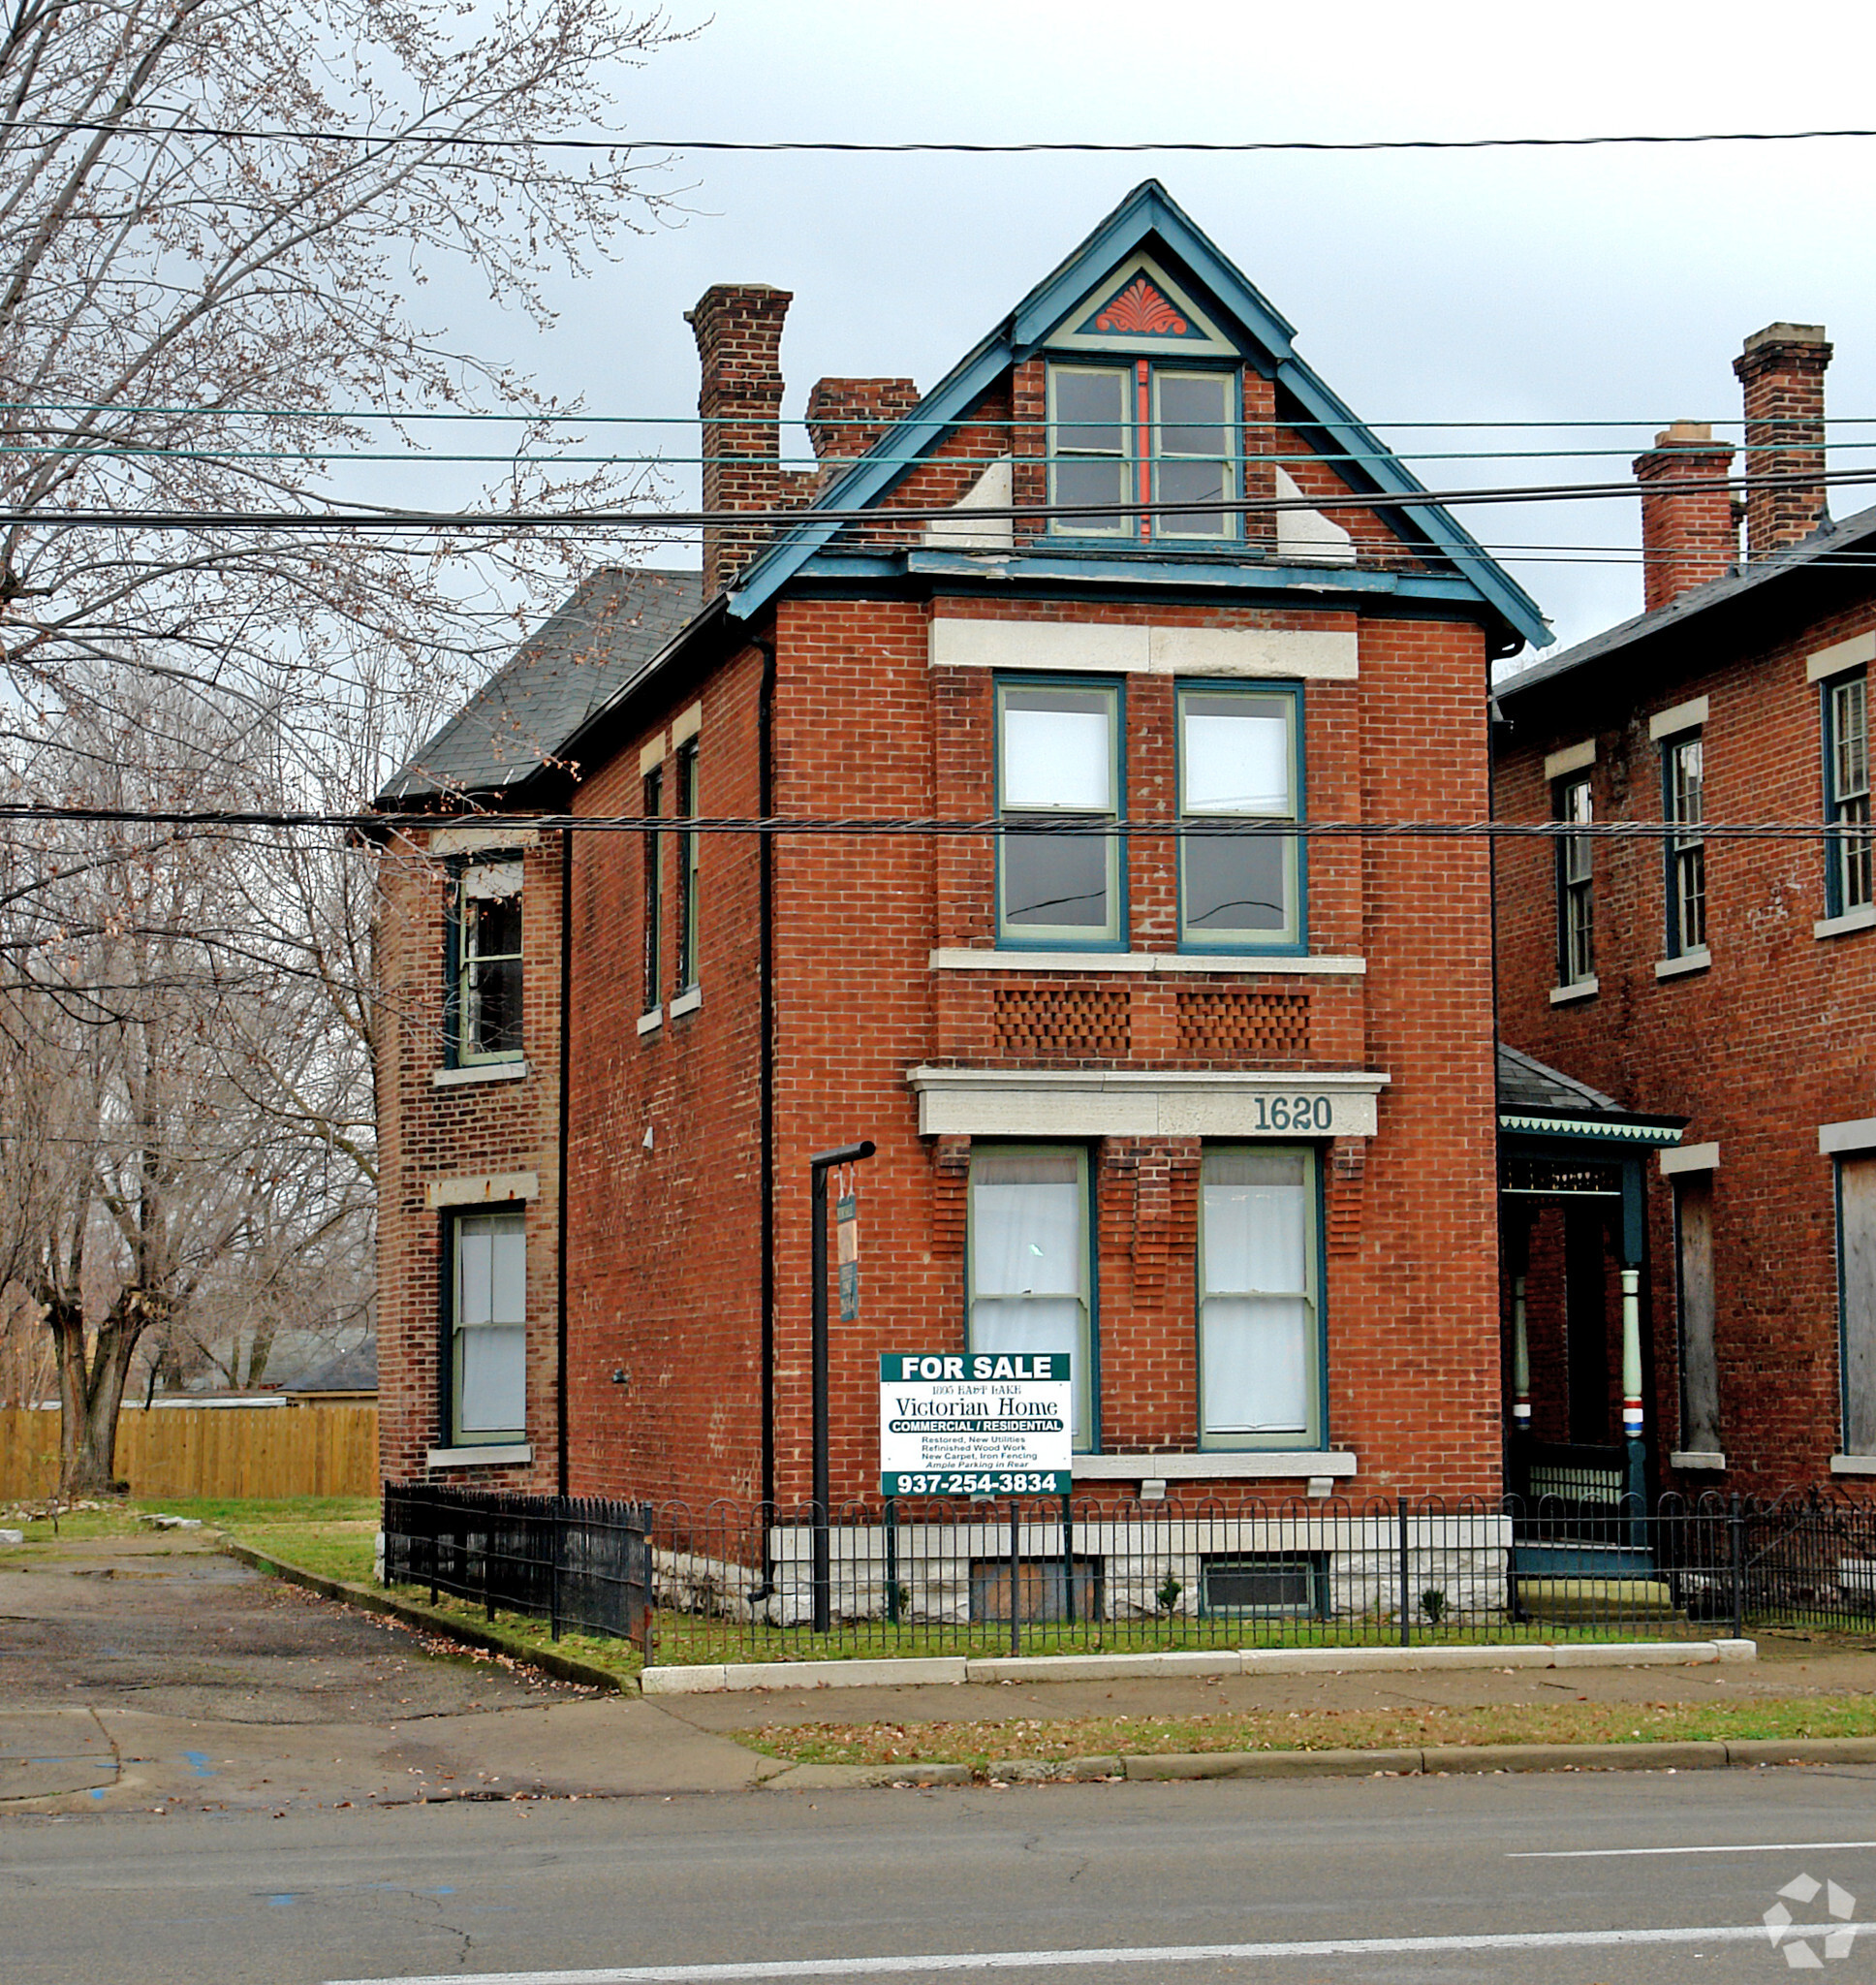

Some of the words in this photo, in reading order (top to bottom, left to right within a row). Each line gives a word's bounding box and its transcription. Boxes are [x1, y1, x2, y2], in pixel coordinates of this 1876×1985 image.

[1254, 1095, 1332, 1130] 1620
[902, 1356, 964, 1379] FOR
[973, 1356, 1052, 1379] SALE
[895, 1398, 989, 1417] Victorian
[997, 1397, 1058, 1416] Home
[891, 1420, 974, 1432] COMMERCIAL
[976, 1421, 982, 1432] /
[983, 1419, 1061, 1432] RESIDENTIAL
[922, 1435, 967, 1444] Restored,
[925, 1461, 956, 1469] Ample
[957, 1461, 993, 1469] Parking
[1007, 1460, 1029, 1468] Rear
[944, 1452, 978, 1462] Carpet,
[1000, 1452, 1038, 1462] Fencing
[897, 1473, 1057, 1493] 937-254-3834
